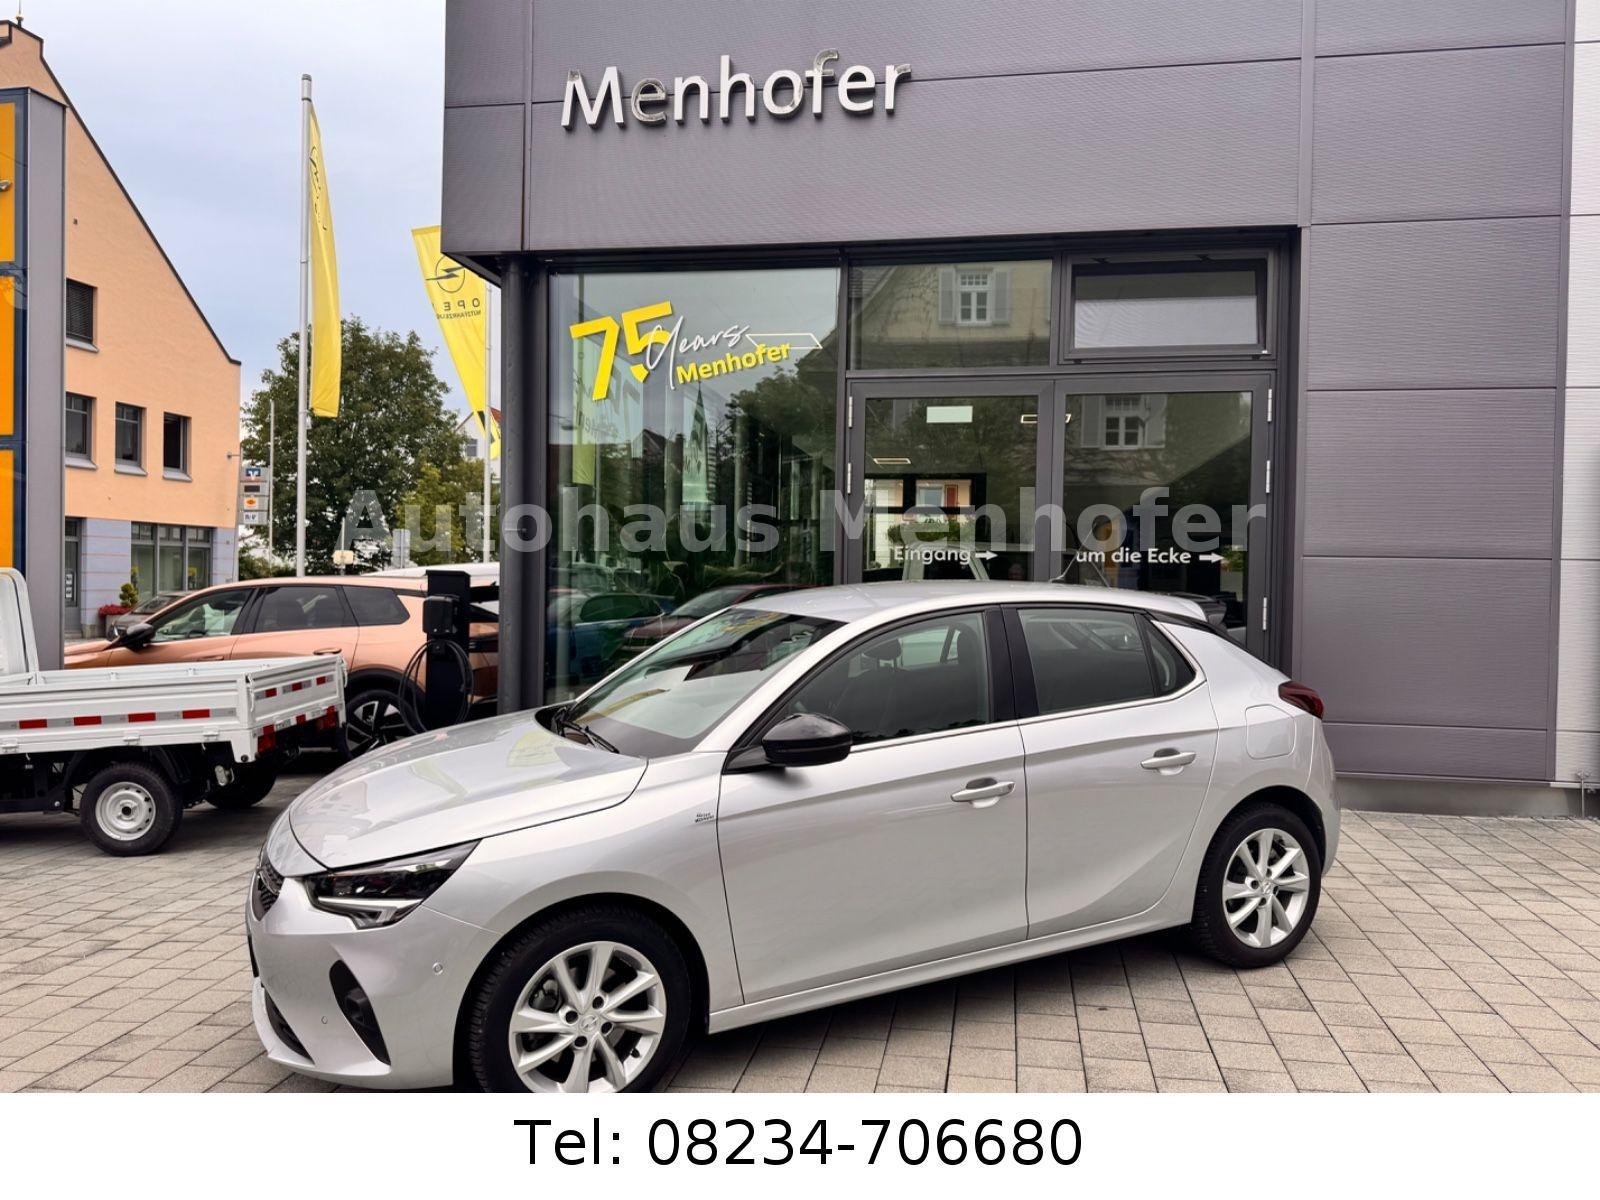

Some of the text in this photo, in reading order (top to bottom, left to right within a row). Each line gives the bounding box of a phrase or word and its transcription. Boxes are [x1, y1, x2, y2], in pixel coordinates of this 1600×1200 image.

[561, 48, 911, 129] Menhofer
[569, 301, 750, 401] 75 Years
[676, 342, 791, 384] Menhofer
[894, 544, 971, 565] Eingang
[1076, 547, 1192, 564] um die Ecke
